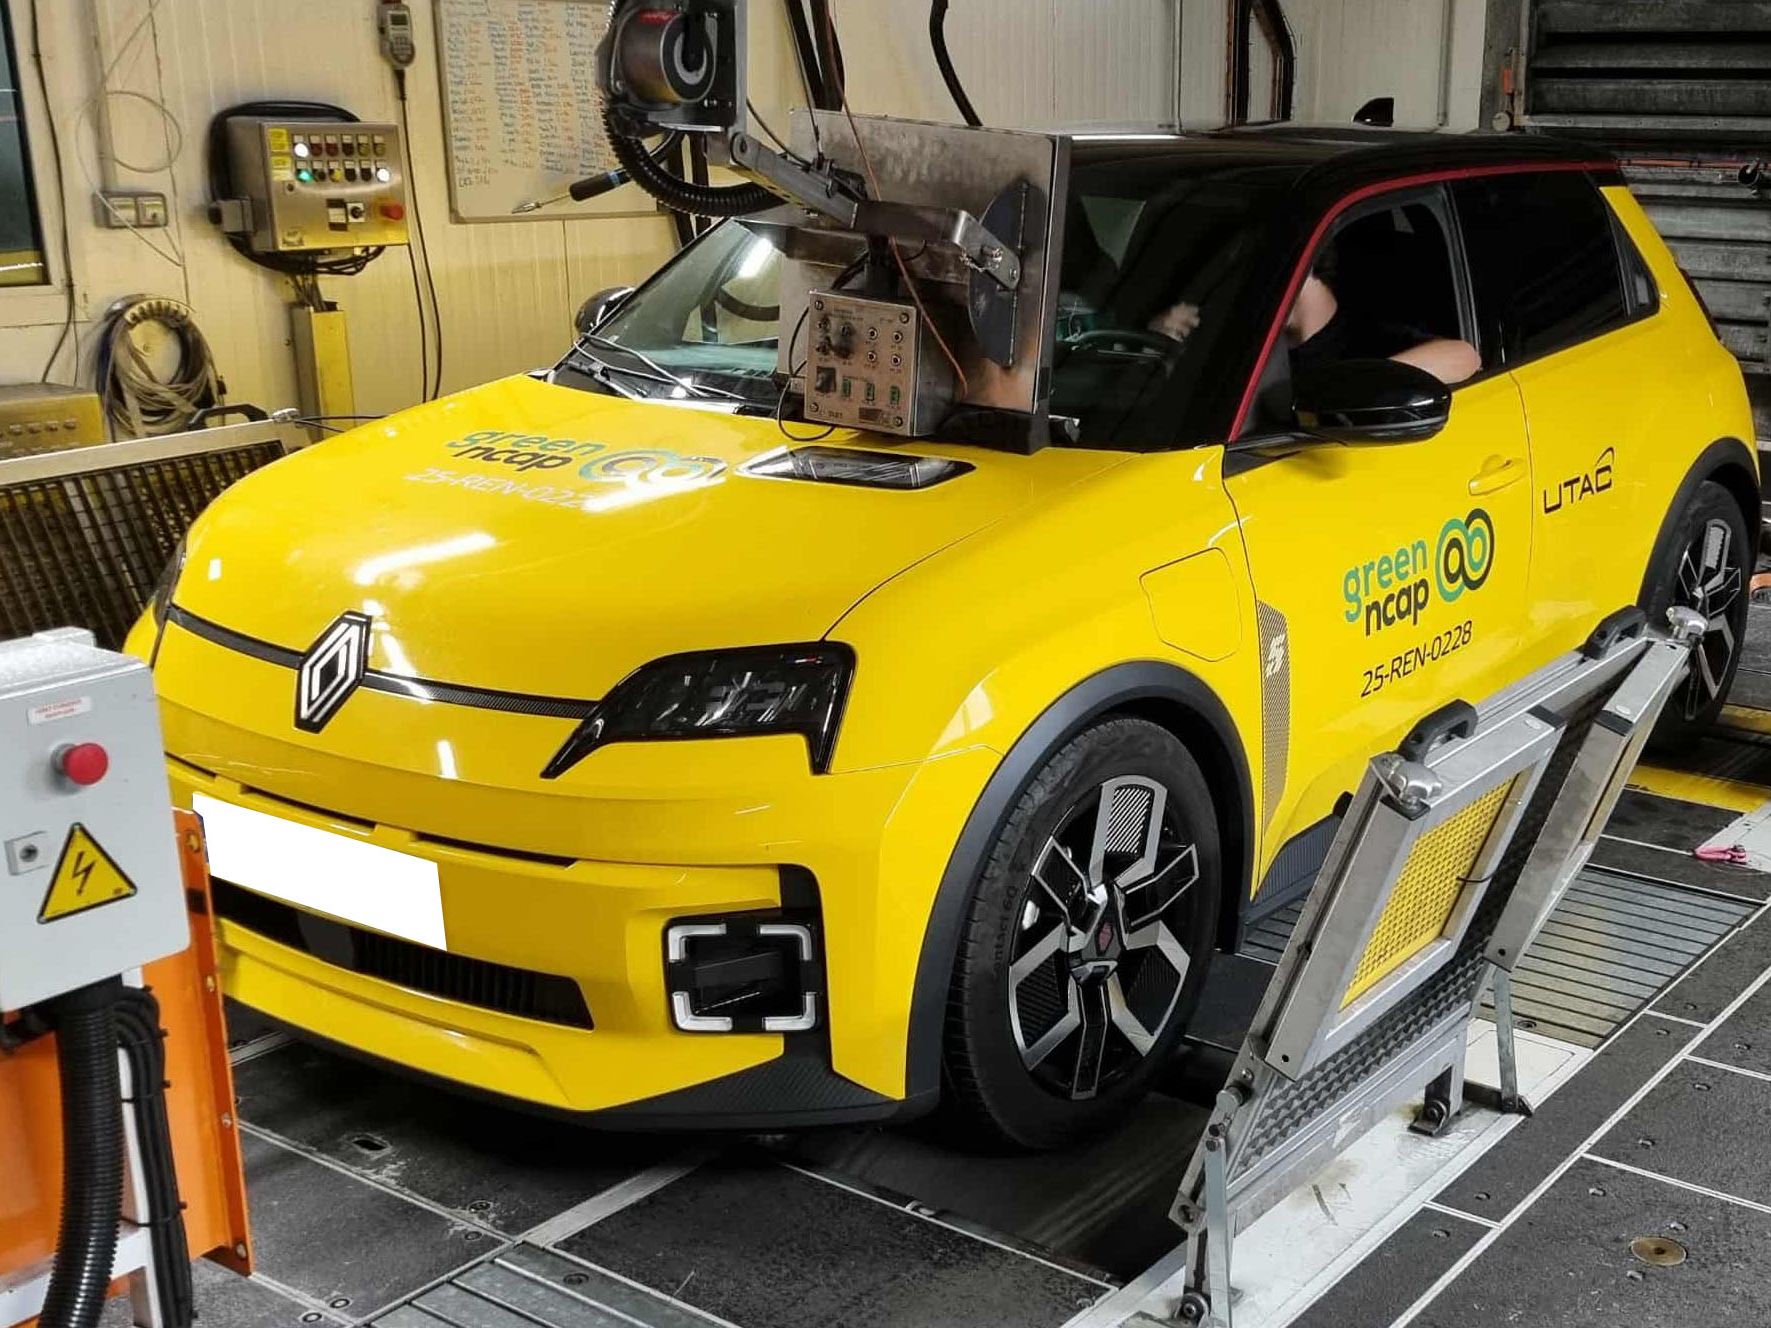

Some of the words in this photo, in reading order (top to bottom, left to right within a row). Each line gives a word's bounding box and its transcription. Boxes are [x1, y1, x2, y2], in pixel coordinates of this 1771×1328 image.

[446, 430, 606, 455] green
[453, 444, 573, 472] ncap
[1543, 464, 1613, 514] UTAC
[1343, 539, 1428, 623] green
[1365, 578, 1430, 636] ncap
[1360, 620, 1473, 698] 25-REN-0228
